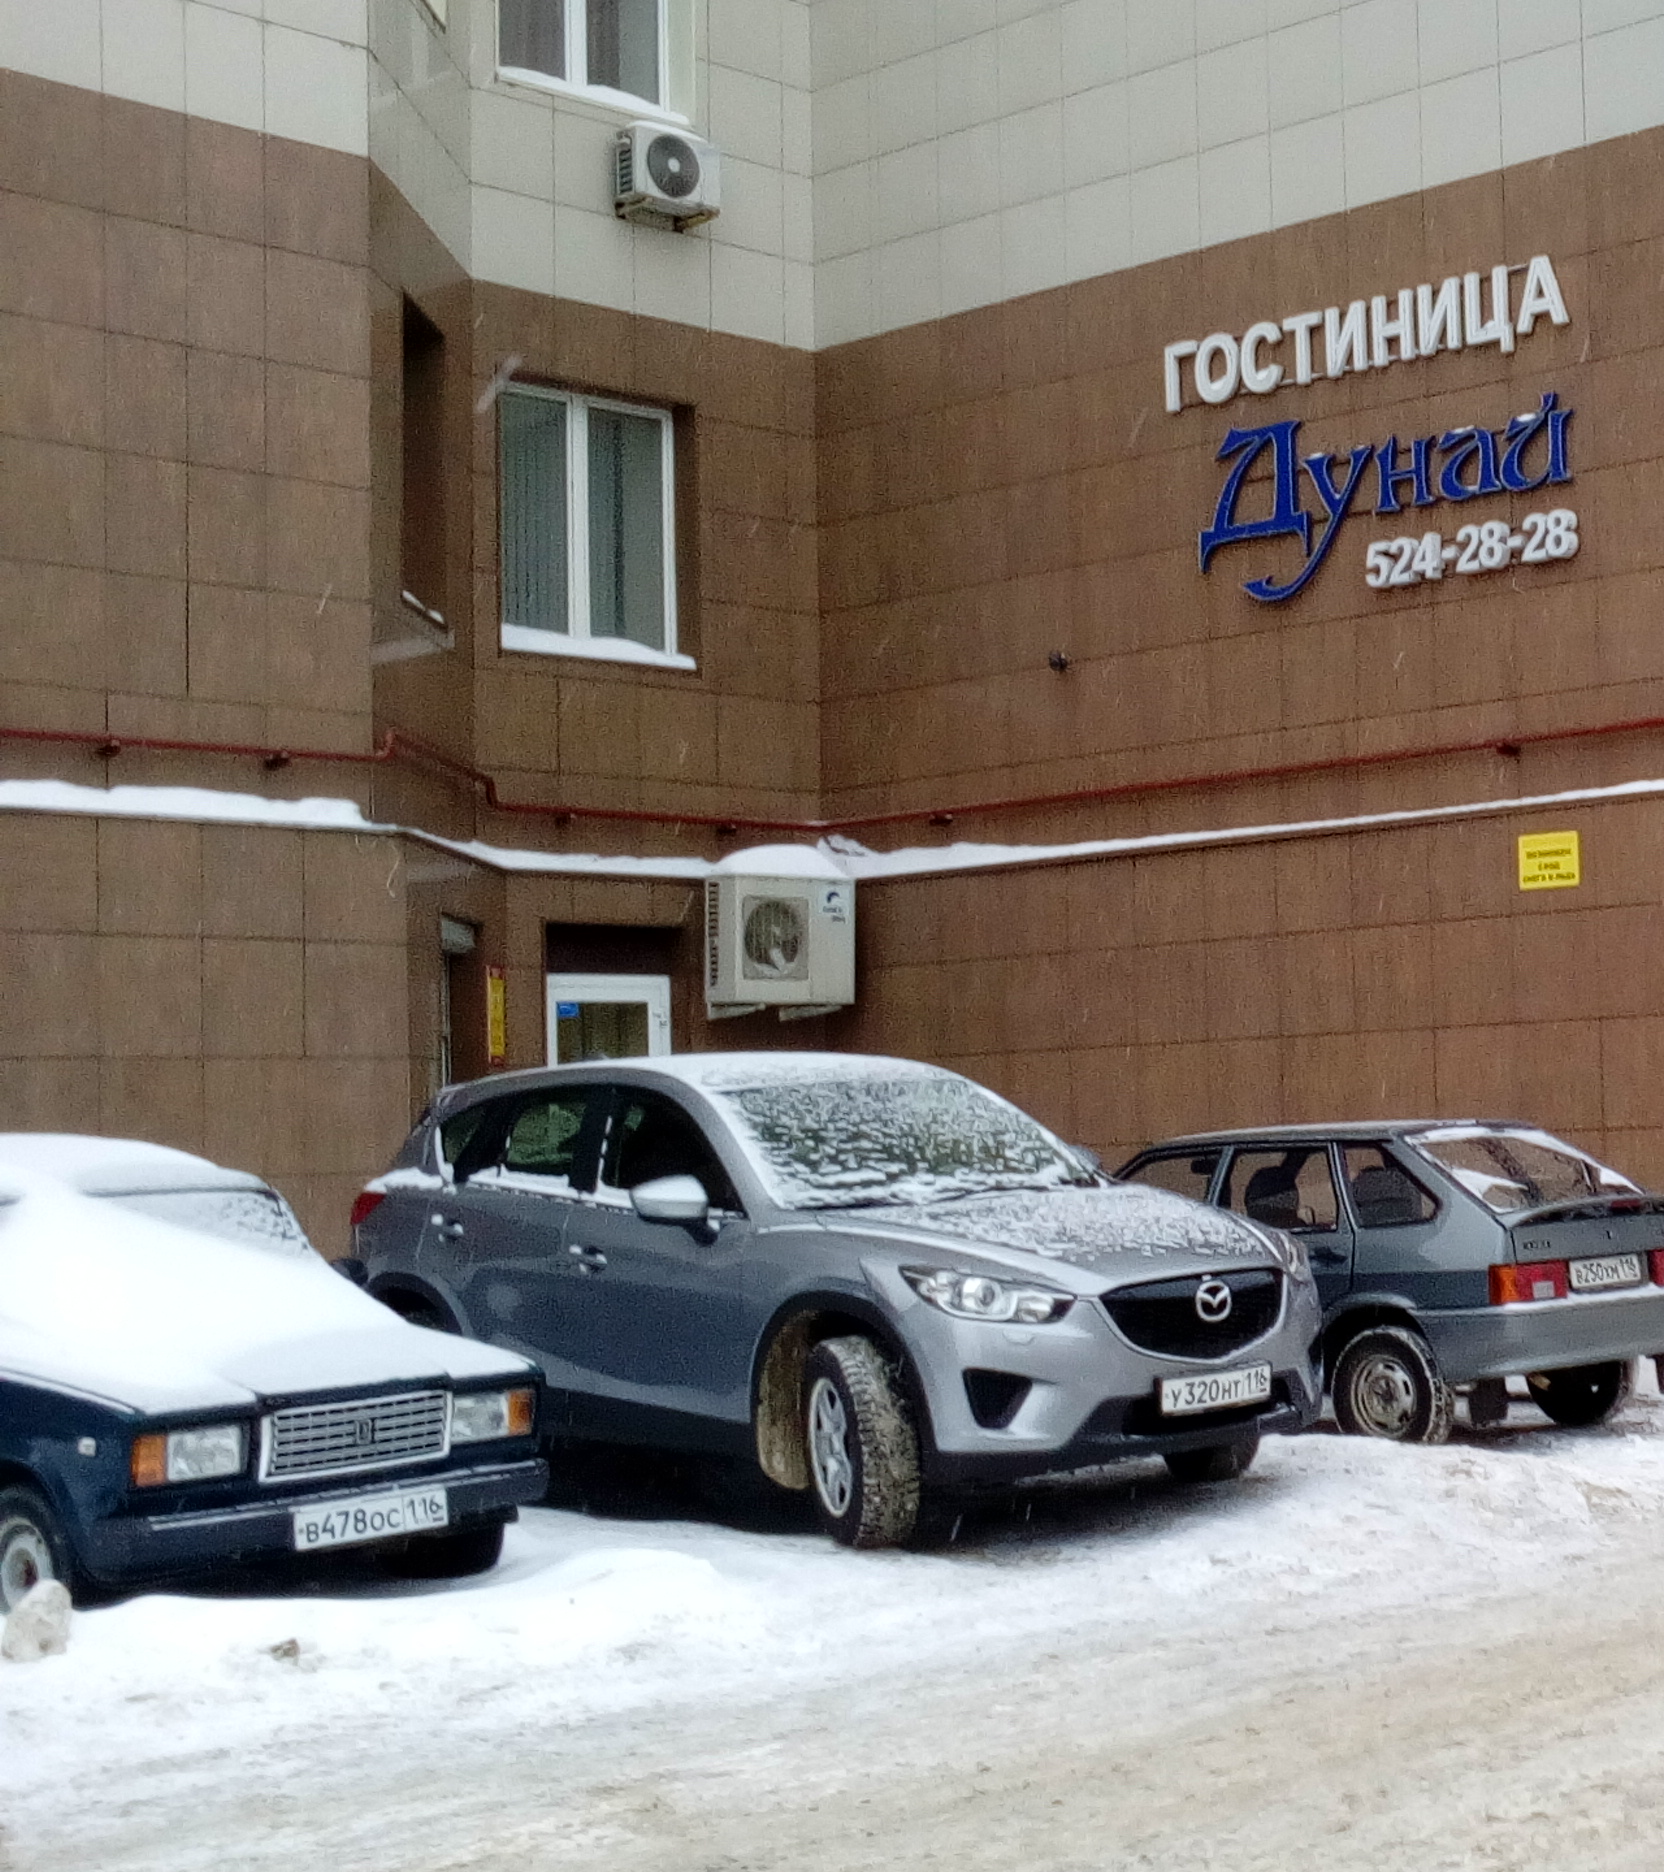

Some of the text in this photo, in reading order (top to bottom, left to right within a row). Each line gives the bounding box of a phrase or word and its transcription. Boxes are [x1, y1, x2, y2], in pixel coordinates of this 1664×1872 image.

[1163, 253, 1571, 413] ГОСТИНИЦА
[1199, 390, 1574, 601] Дунай
[1365, 508, 1580, 589] 524-28-28
[1170, 1369, 1269, 1409] У320НТ 116
[304, 1494, 444, 1544] В478ОС 116
